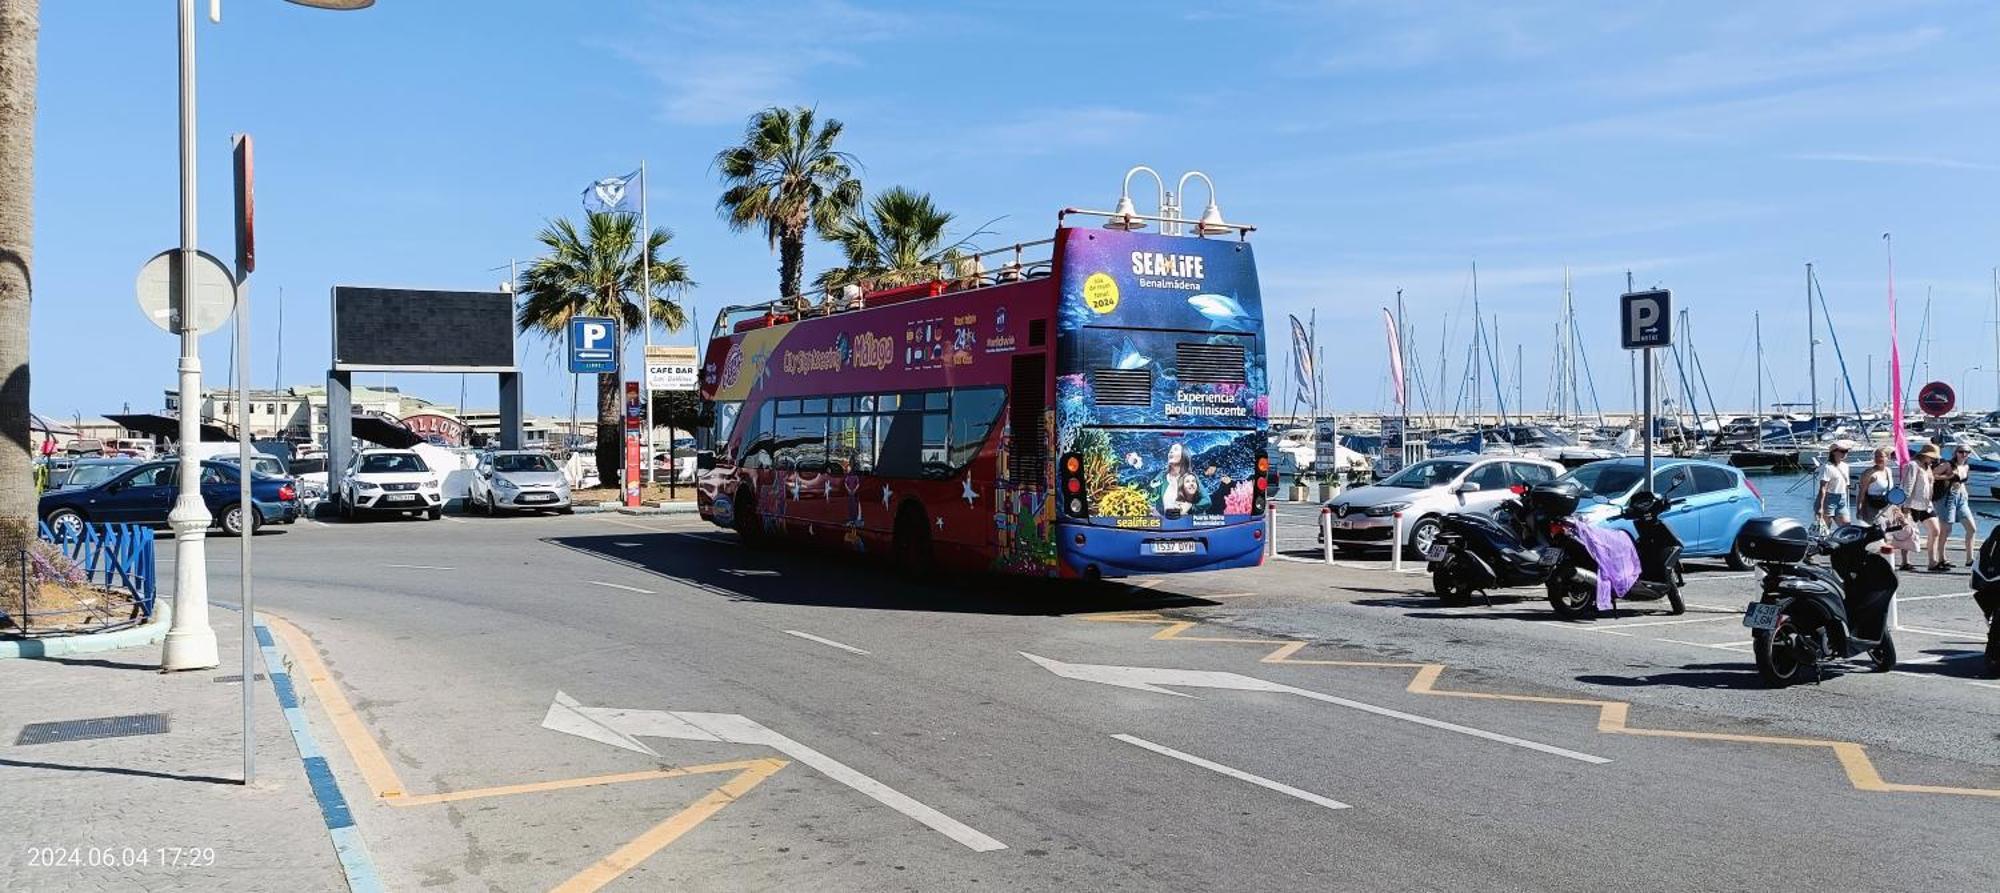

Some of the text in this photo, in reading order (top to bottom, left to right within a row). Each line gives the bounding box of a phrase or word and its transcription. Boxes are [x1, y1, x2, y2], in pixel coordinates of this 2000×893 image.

[1139, 278, 1201, 291] Benalmádena
[1092, 298, 1114, 308] 2024
[1631, 298, 1660, 342] P
[583, 323, 606, 349] P
[853, 330, 894, 371] Málaga
[1177, 390, 1235, 405] Experiencia
[1164, 402, 1247, 417] Bioluminiscente
[1116, 516, 1161, 527] sealife.es
